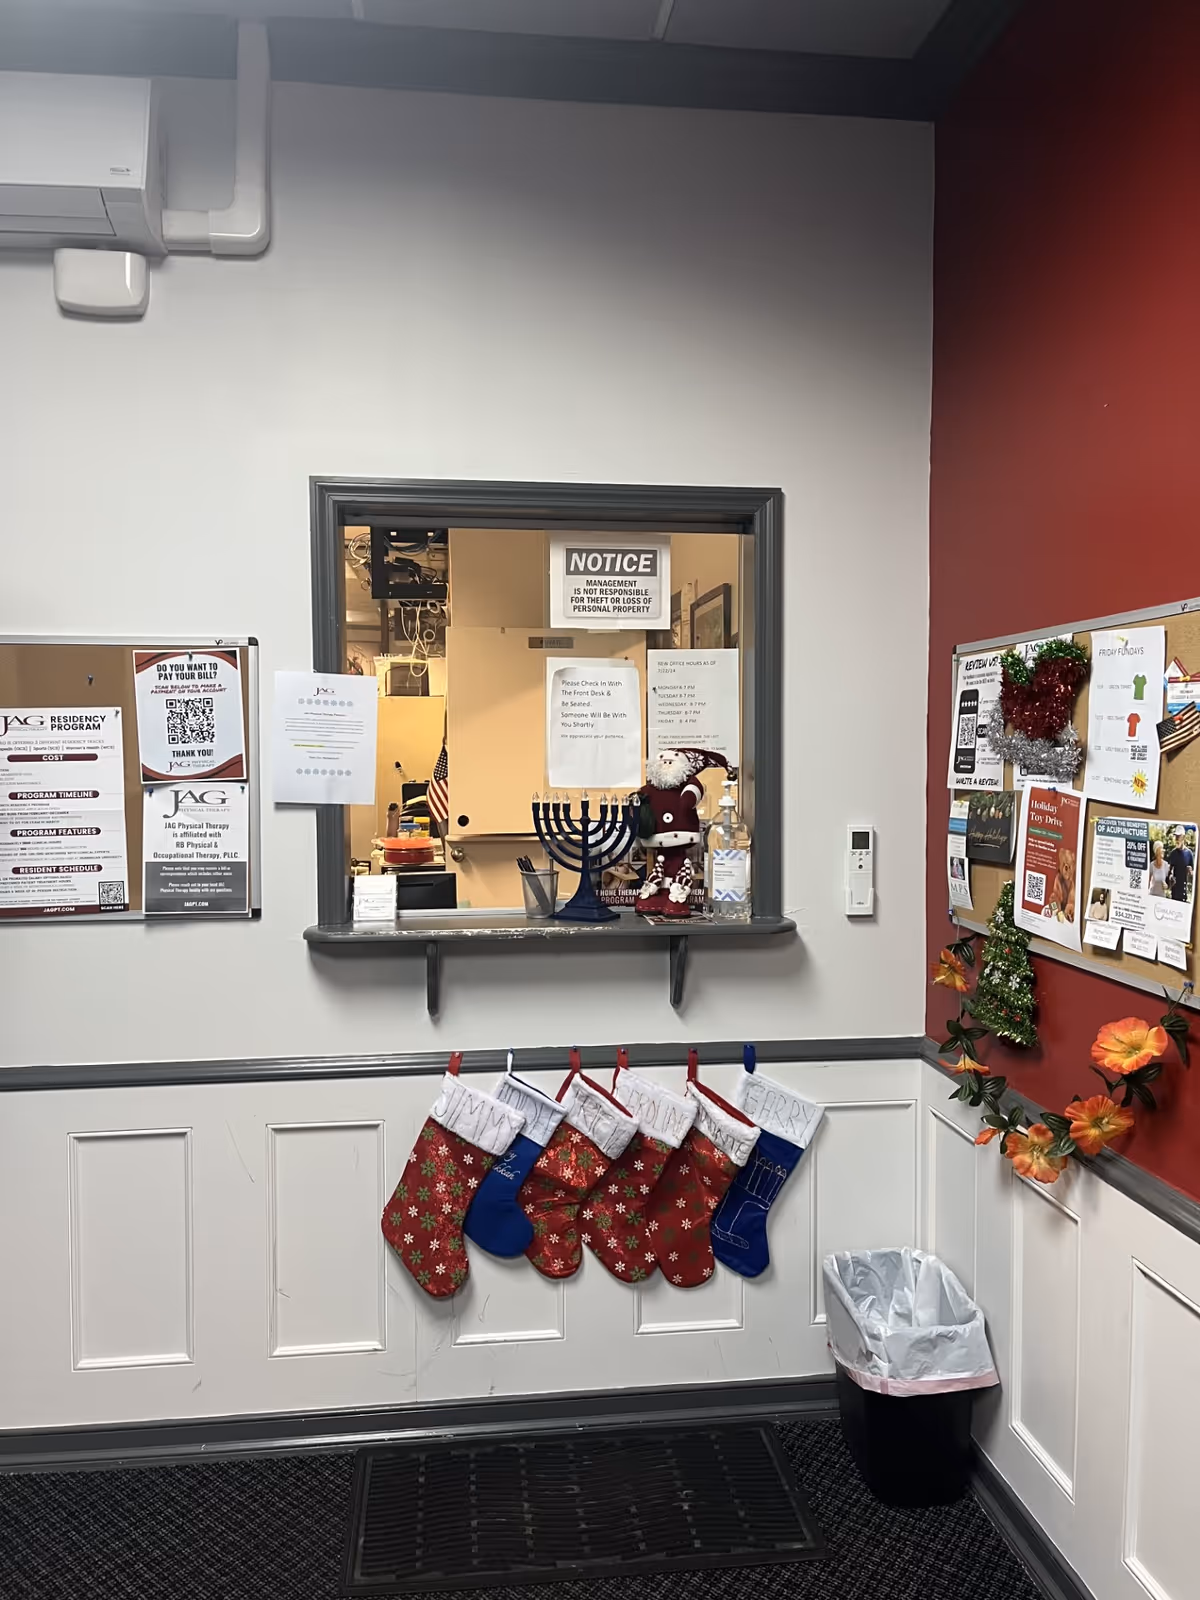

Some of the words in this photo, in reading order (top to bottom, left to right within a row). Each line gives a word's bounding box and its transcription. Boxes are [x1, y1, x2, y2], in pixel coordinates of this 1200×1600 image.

[570, 552, 653, 572] NOTICE
[600, 588, 649, 596] RESPONSIBLE
[1098, 648, 1117, 656] FRIDAY
[1118, 647, 1144, 656] FUNDAYS
[157, 664, 168, 672] DO
[170, 664, 184, 672] YOU
[187, 663, 206, 671] WANT
[176, 672, 195, 680] YOUR
[198, 672, 217, 680] BILL?
[0, 716, 44, 736] JAG
[50, 715, 106, 723] RESIDENCY
[50, 723, 101, 731] PROGRAM
[172, 750, 196, 758] THANK
[198, 749, 214, 757] YOU!
[166, 761, 190, 772] JAG
[59, 790, 93, 798] TIMELINE
[162, 790, 230, 818] JAG
[1031, 800, 1058, 814] Holiday
[1030, 812, 1044, 824] Toy
[1045, 815, 1063, 826] Drive
[178, 822, 204, 830] Physical
[205, 822, 230, 830] Therapy
[59, 828, 96, 836] FEATURES
[1106, 826, 1148, 838] ACUPUNCTURE
[1127, 842, 1136, 850] 20%
[1137, 843, 1146, 852] OFF
[153, 852, 194, 860] Occupational
[196, 852, 222, 860] Therapy,
[618, 888, 640, 896] THERAP
[600, 896, 635, 904] PROGRAM
